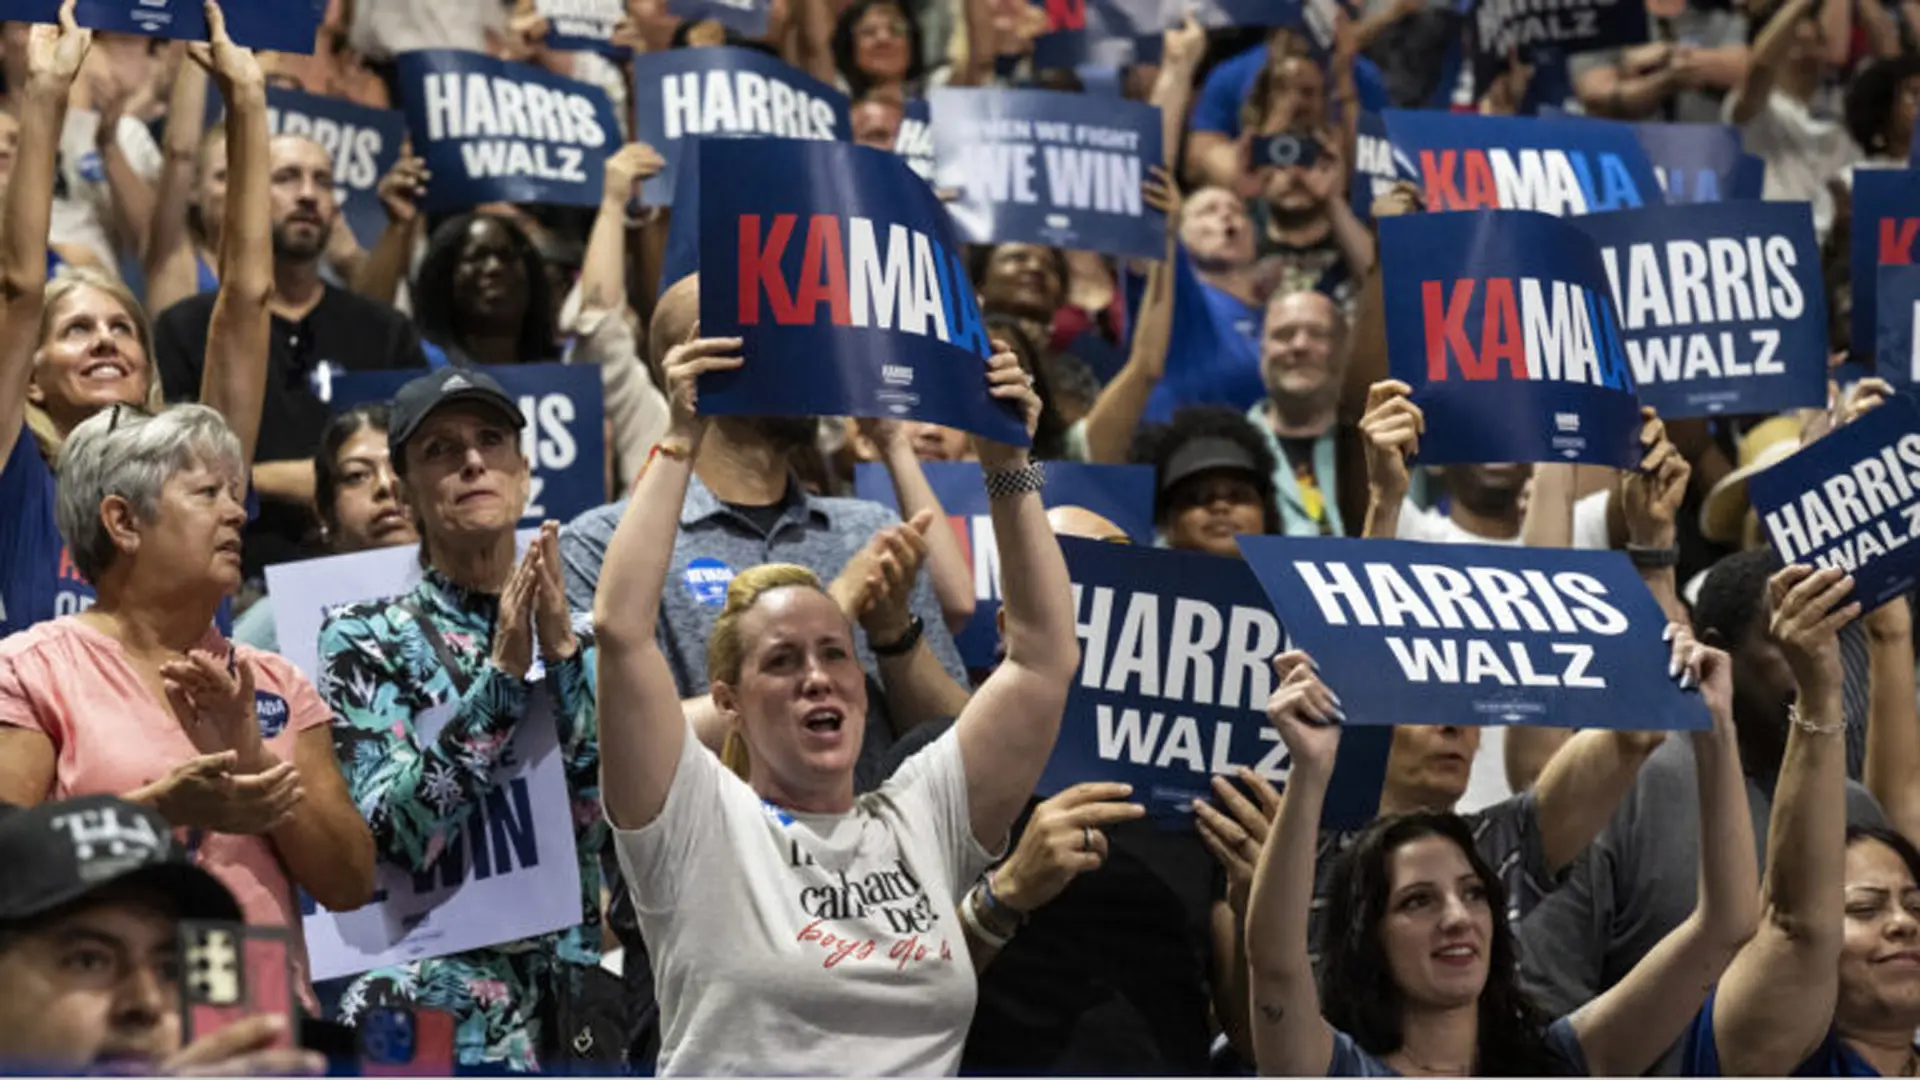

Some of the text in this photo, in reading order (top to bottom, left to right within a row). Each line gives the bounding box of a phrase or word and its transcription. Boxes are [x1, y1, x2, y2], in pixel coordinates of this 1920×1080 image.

[423, 72, 606, 148] HARRIS
[661, 69, 837, 141] HARRIS
[972, 117, 1032, 140] HEN
[460, 140, 588, 183] WALZ
[1043, 146, 1142, 217] WIN
[1420, 146, 1644, 218] KAMALA
[737, 212, 992, 361] KAMALA
[1624, 329, 1786, 385] WALZ
[1764, 432, 1920, 565] HARRIS
[1292, 560, 1630, 635] HARRIS
[1071, 581, 1293, 714] HARR
[1384, 636, 1607, 689] WALZ
[1096, 704, 1297, 783] WALZ
